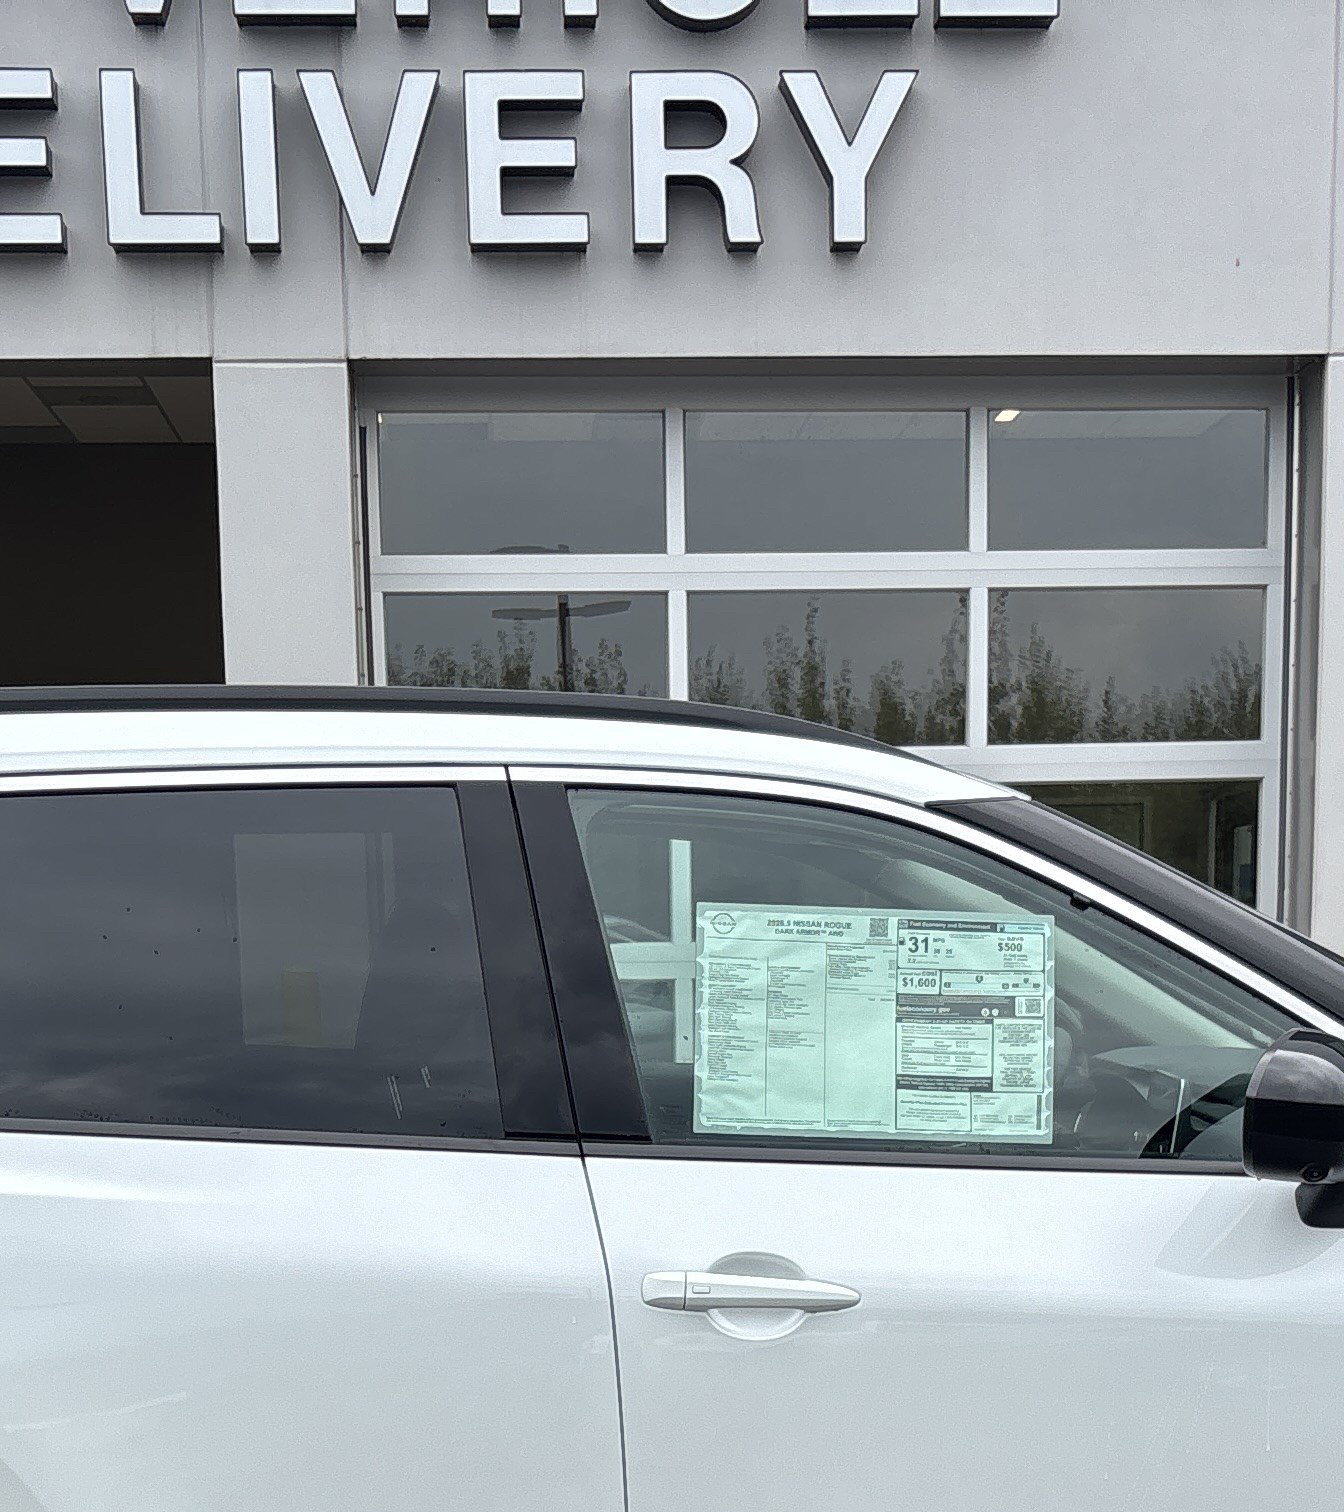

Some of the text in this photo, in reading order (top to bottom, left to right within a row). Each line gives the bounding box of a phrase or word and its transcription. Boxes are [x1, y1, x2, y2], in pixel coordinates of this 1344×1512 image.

[824, 921, 852, 930] ROGUE
[908, 936, 929, 953] 31
[997, 942, 1023, 953] $500
[902, 976, 937, 989] $1,600
